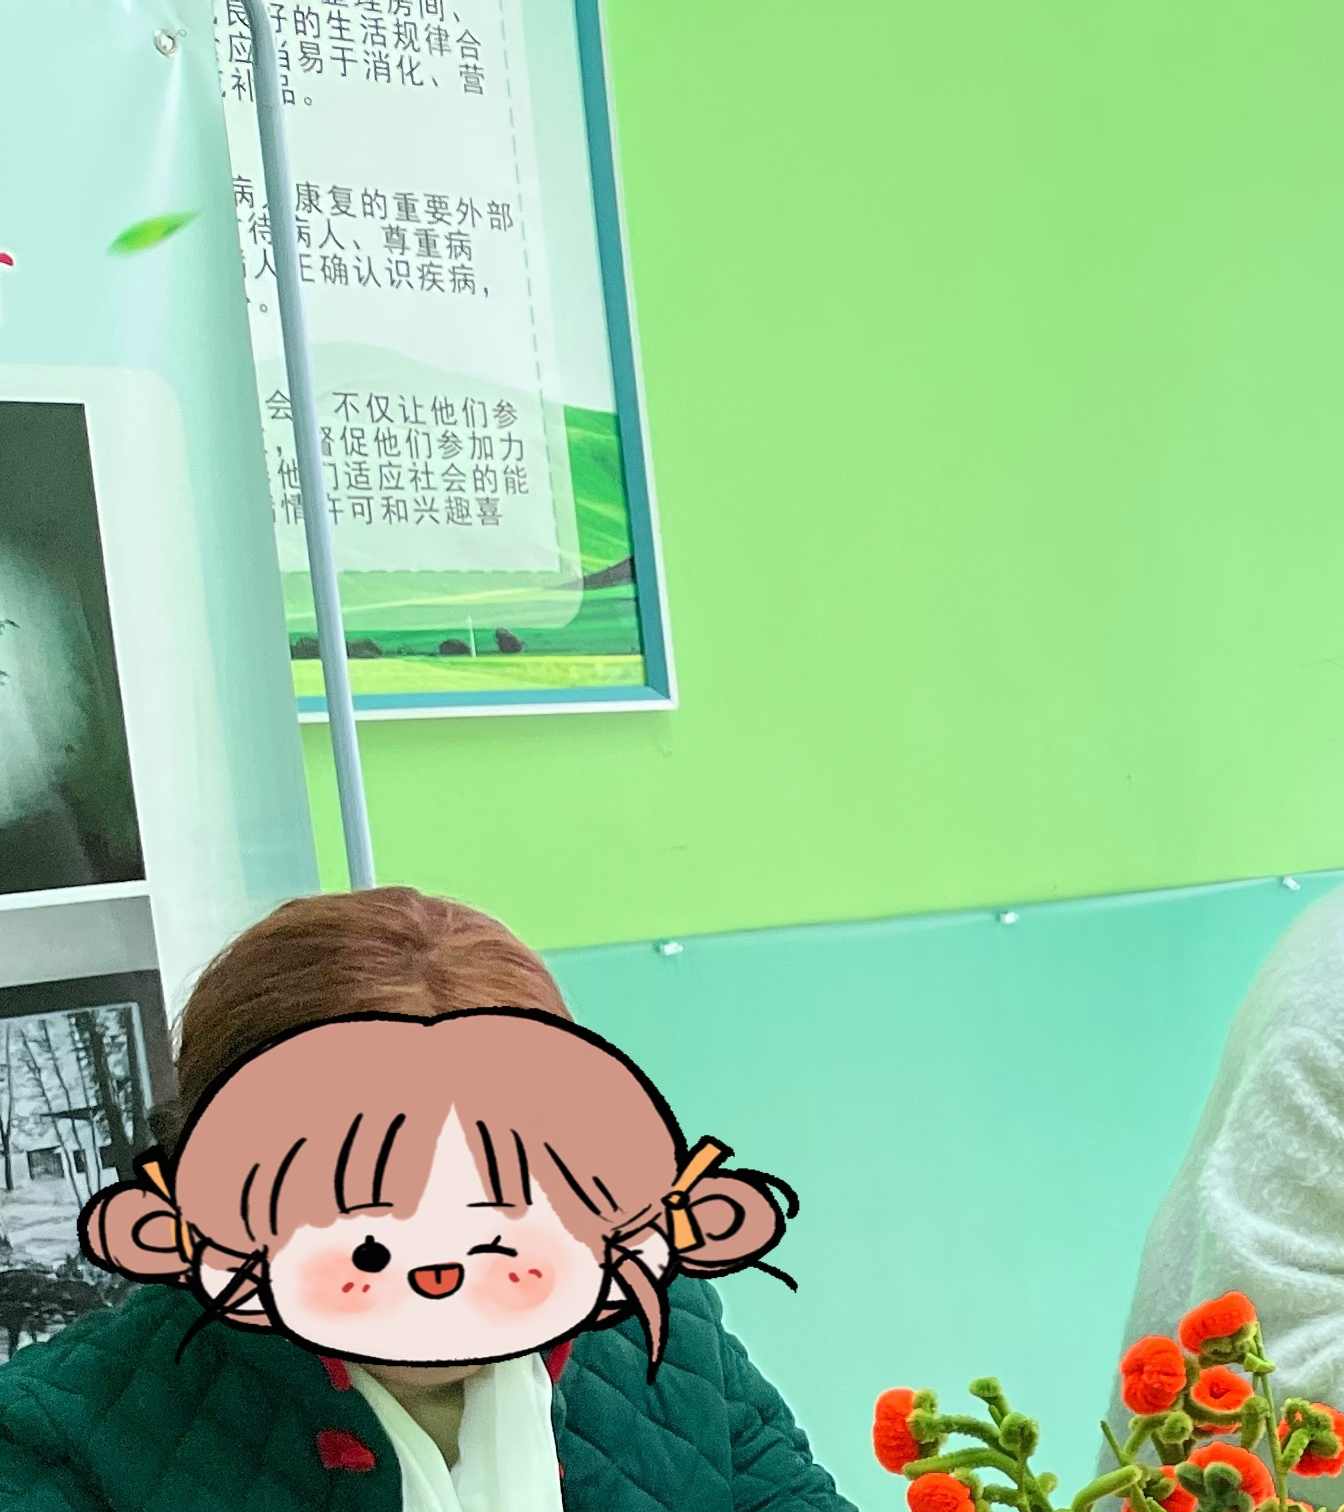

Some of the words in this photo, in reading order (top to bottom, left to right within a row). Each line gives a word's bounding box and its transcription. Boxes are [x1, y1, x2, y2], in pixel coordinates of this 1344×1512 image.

[232, 175, 514, 232] 病康复的重要外部
